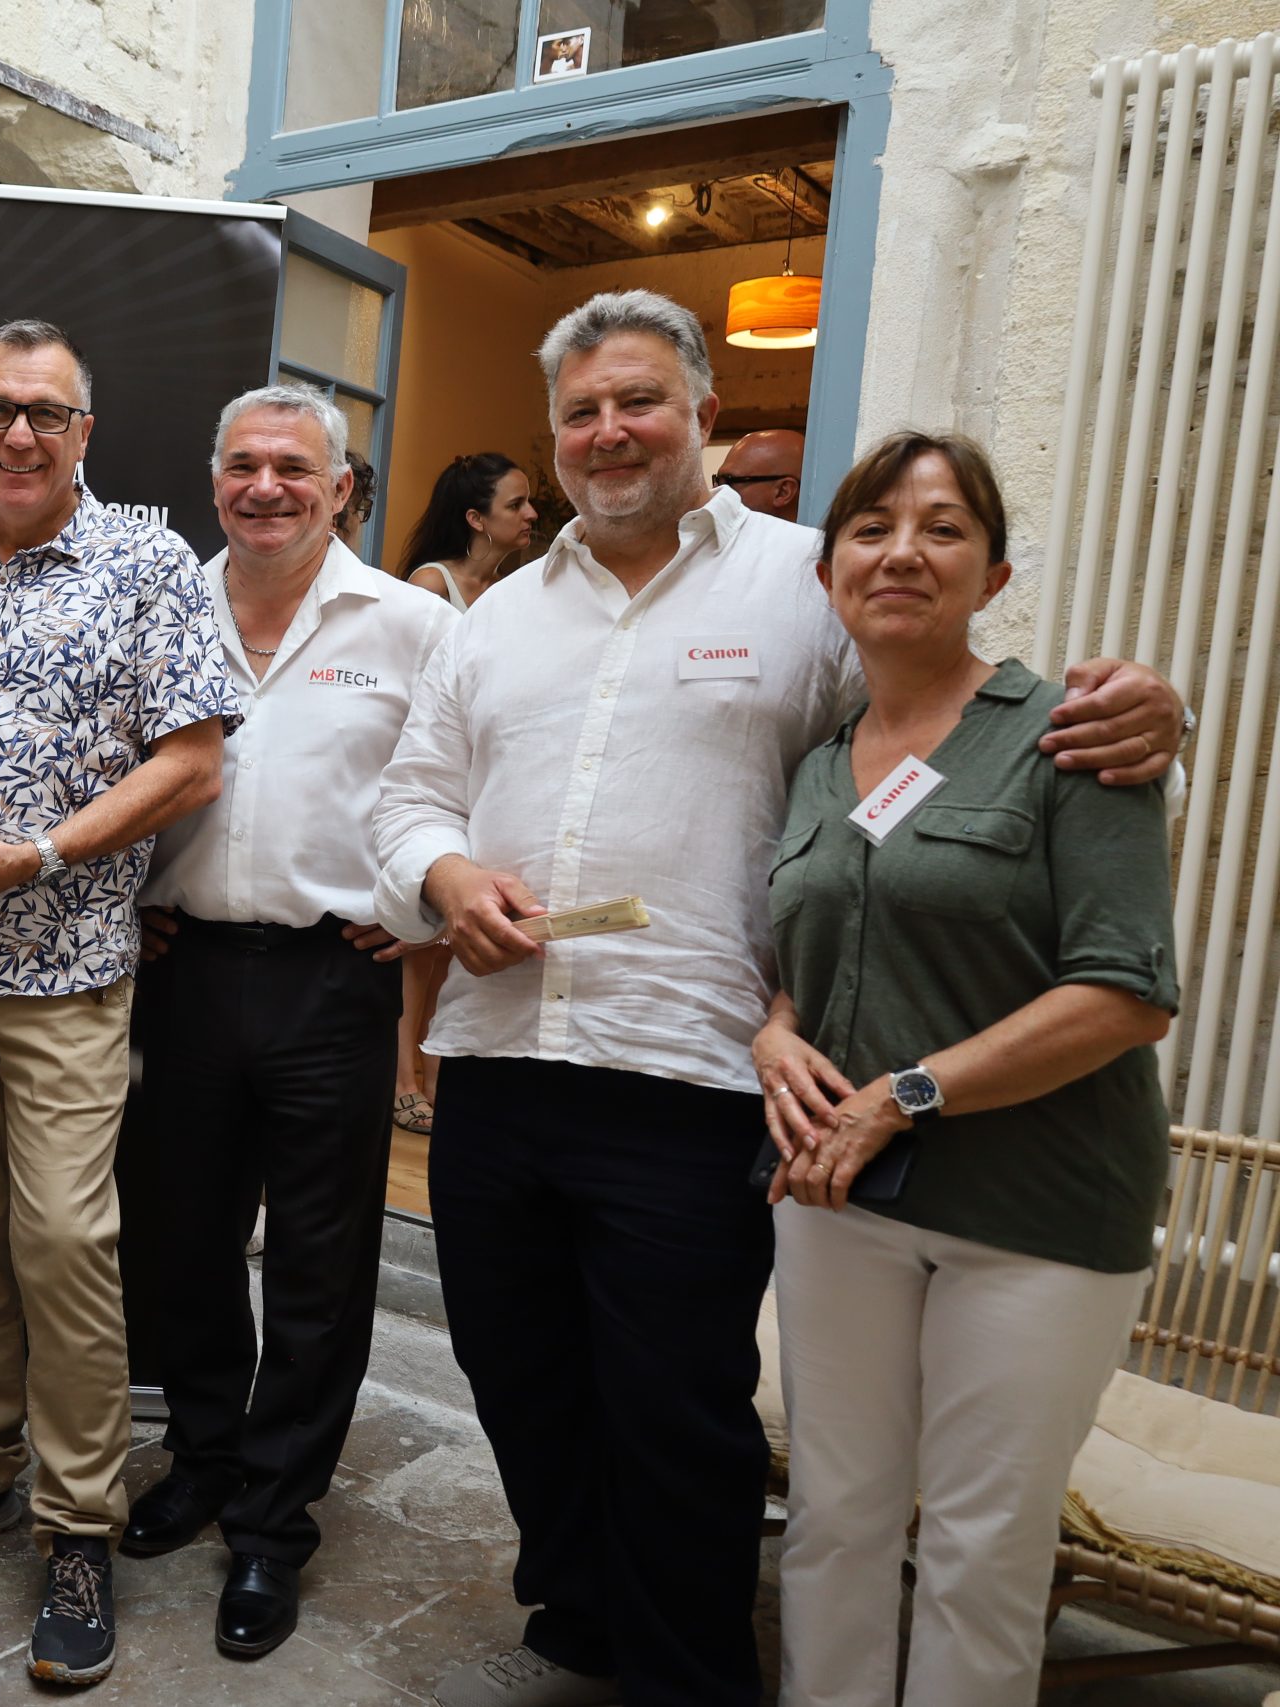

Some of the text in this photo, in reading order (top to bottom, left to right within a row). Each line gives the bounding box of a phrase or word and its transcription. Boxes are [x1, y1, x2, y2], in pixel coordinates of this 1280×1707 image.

[688, 648, 749, 660] Canon
[310, 669, 378, 688] MBTECH
[867, 770, 920, 820] Canon
